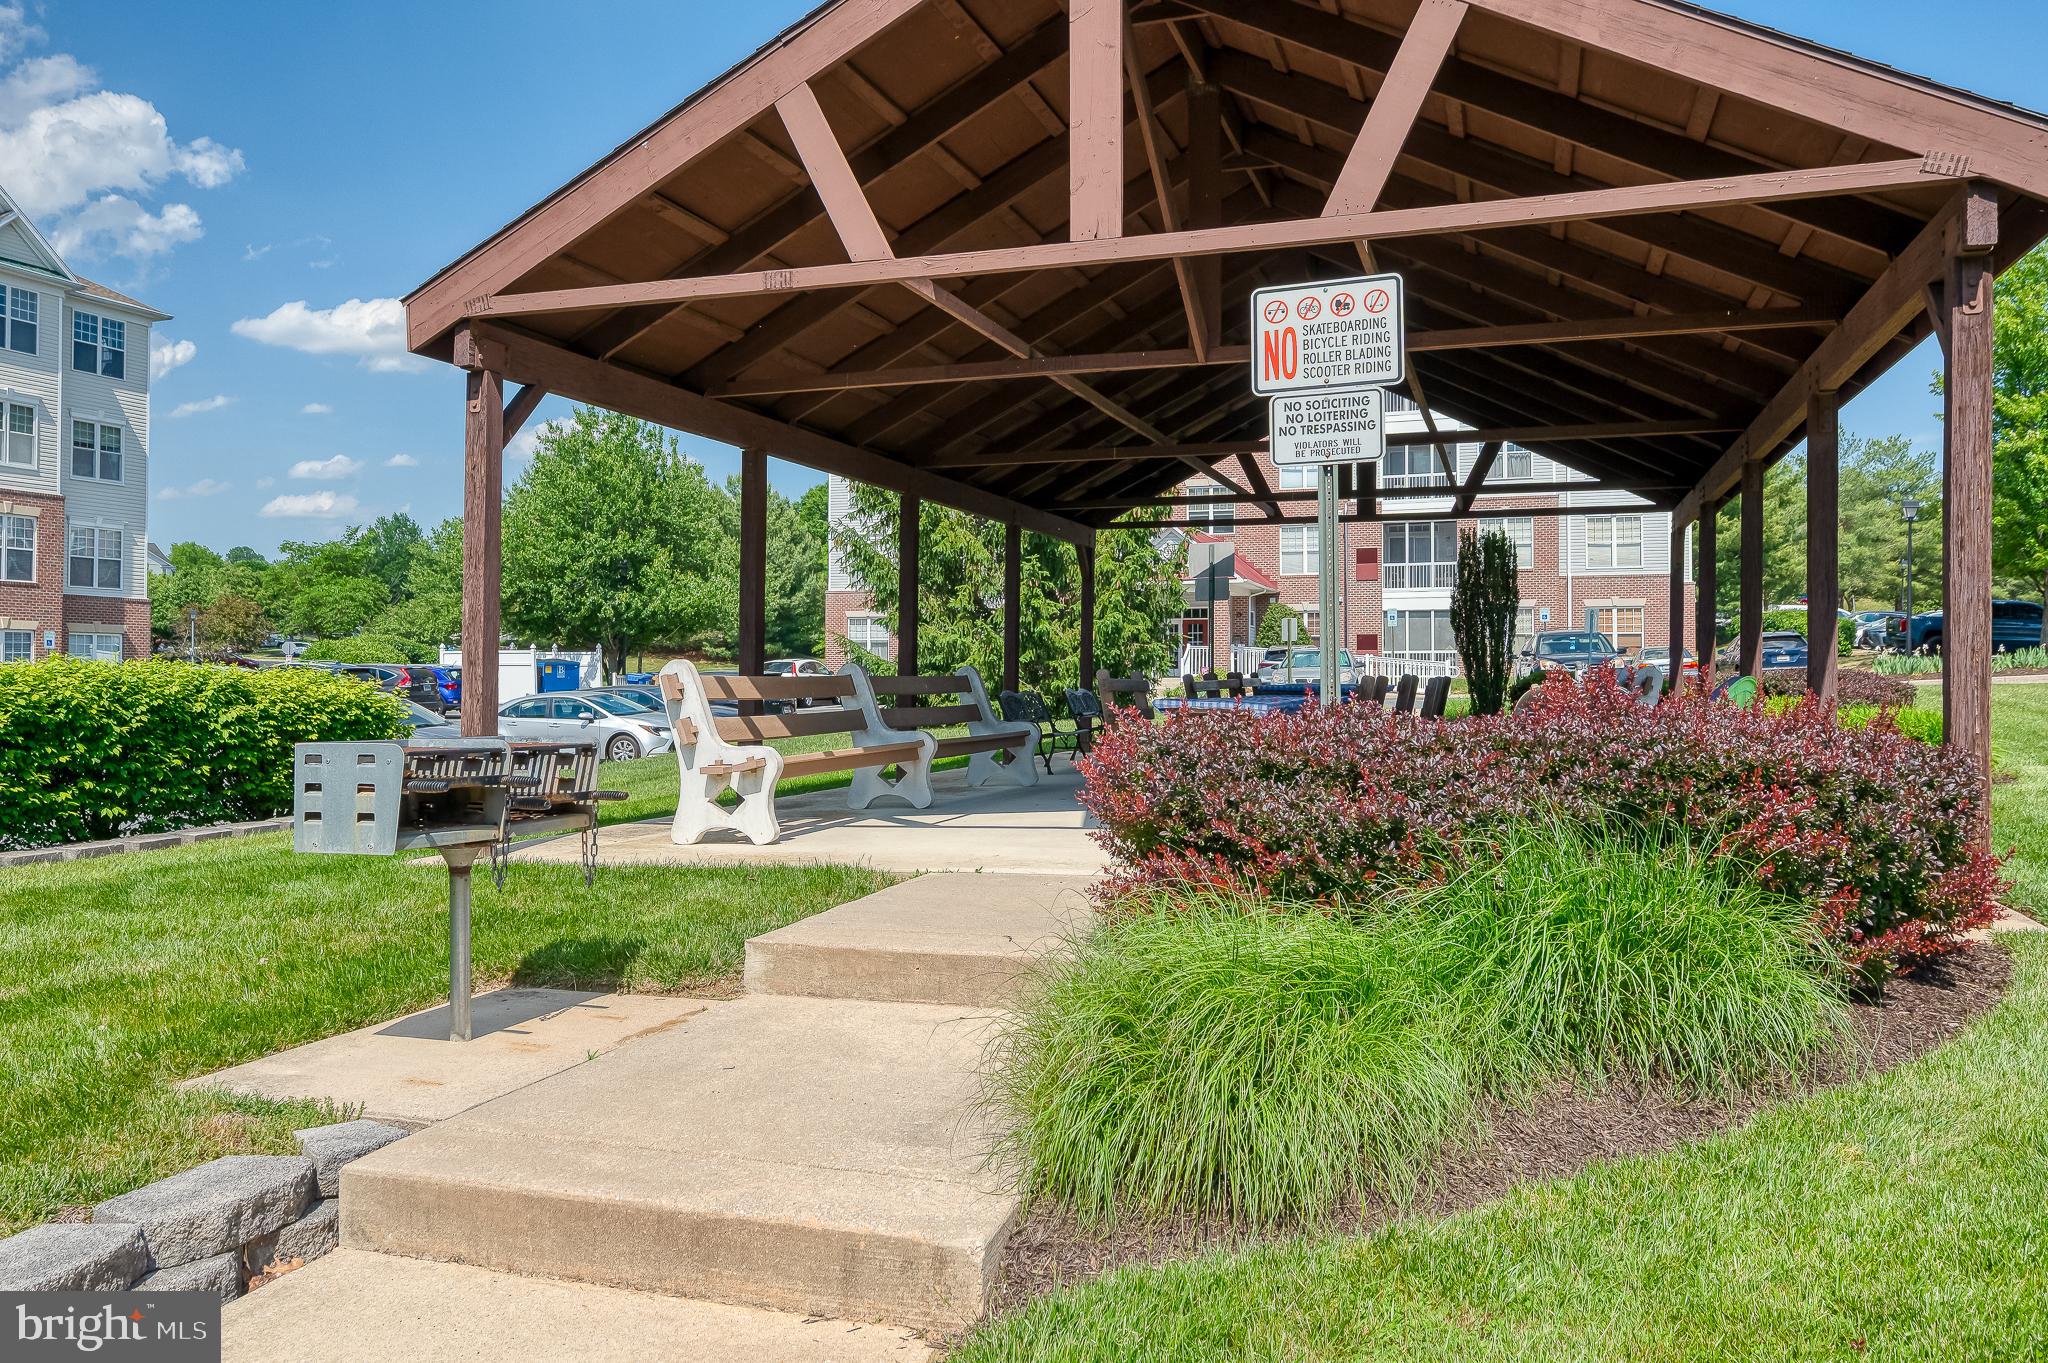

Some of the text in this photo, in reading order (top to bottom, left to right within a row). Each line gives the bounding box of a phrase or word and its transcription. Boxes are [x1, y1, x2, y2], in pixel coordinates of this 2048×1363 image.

[1302, 317, 1387, 336] SKATEBOARDING
[1303, 331, 1391, 350] BICYCLE RIDING
[1264, 327, 1298, 381] NO
[1303, 346, 1392, 365] ROLLER BLADING
[1303, 360, 1392, 379] SCOOTER RIDING
[1284, 396, 1370, 412] NO SOLICITING
[1286, 408, 1369, 424] NO LOITERING
[1279, 420, 1376, 436] NO TRESPASSING
[1294, 438, 1362, 449] VIOLATORS WILL
[1310, 446, 1361, 457] PROSECUTED
